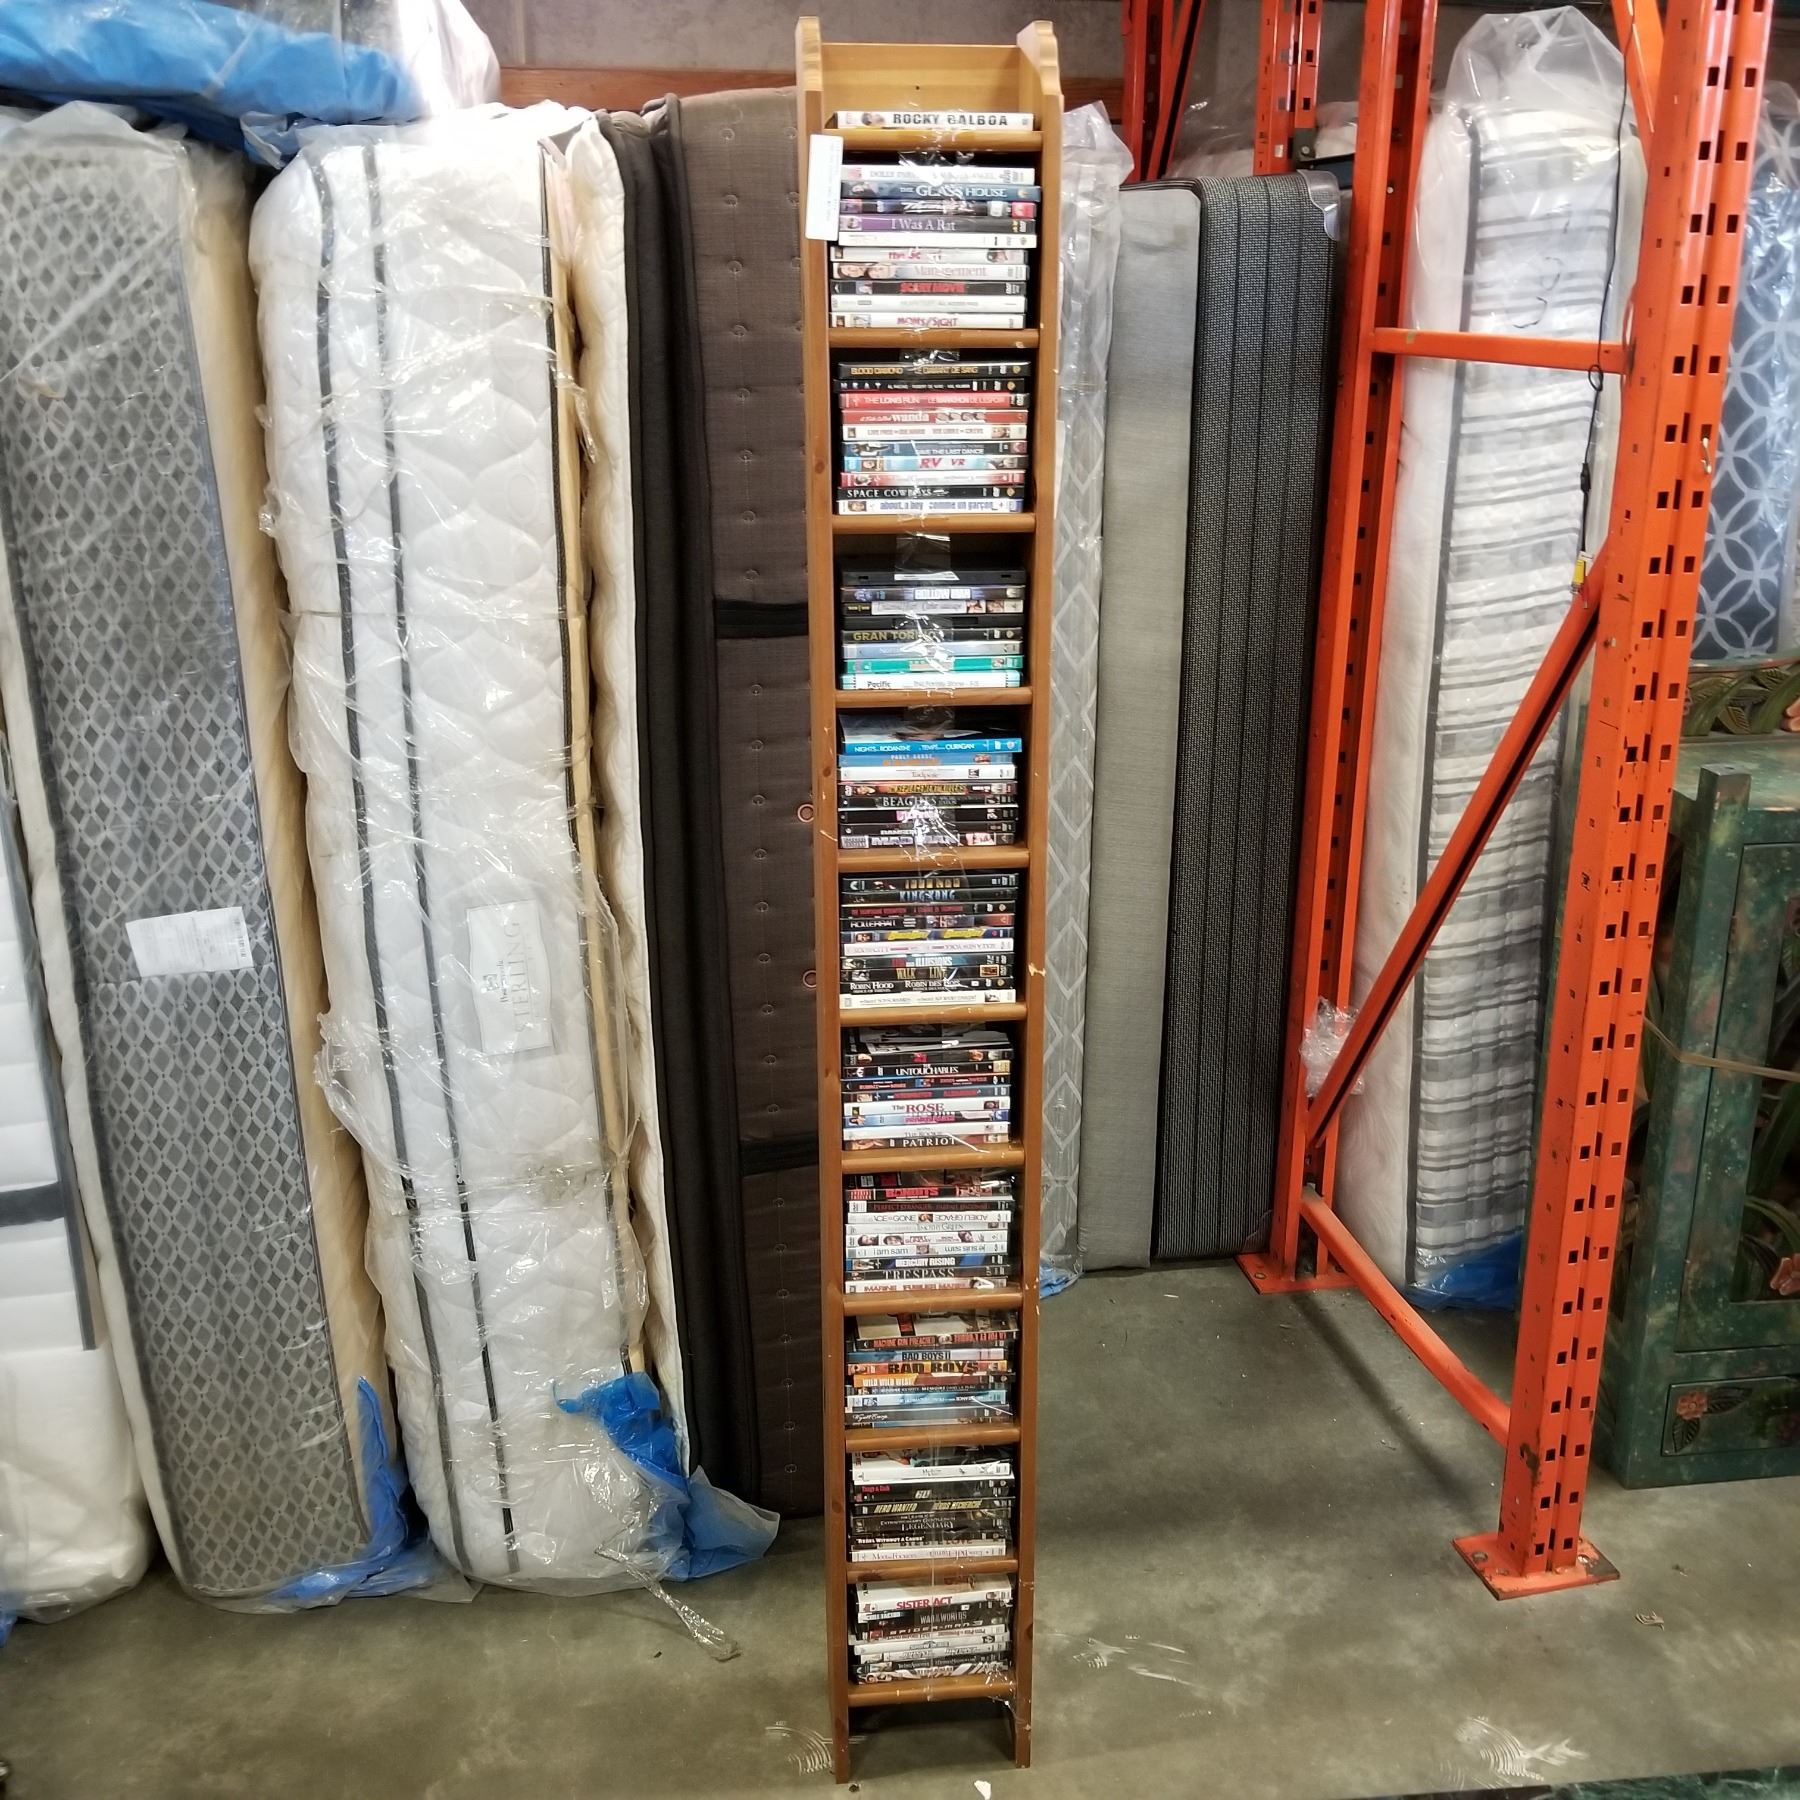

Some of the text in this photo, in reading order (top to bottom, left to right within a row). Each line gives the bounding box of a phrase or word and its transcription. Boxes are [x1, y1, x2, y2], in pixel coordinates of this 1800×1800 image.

[893, 113, 1008, 125] ROCKY BALBOA
[915, 185, 962, 198] GLASS
[965, 187, 1007, 198] HOUSE
[891, 218, 956, 232] I Was A Rat
[864, 396, 879, 404] THE
[879, 396, 902, 404] LONG
[919, 458, 966, 469] RV VR
[847, 489, 880, 498] SPACE
[853, 632, 887, 641] GRAN
[900, 890, 956, 901] KING KONG
[915, 956, 953, 966] ILLUSIONS
[896, 966, 948, 979] WALK LINE
[850, 982, 871, 990] ROBIN
[872, 981, 894, 990] HOOD
[904, 980, 927, 988] ROBIN
[895, 1066, 959, 1076] UNTOUCHABLES
[905, 1103, 944, 1113] ROSE
[902, 1137, 957, 1148] PATRIOT
[895, 1258, 956, 1267] MERCURY RISING
[882, 1268, 955, 1280] TRESPASS
[873, 1338, 897, 1347] MACHINE
[902, 1351, 950, 1360] BAD BOYS II
[888, 1361, 979, 1374] BAD BOYS
[862, 1377, 914, 1387] WILD WILD WEST
[874, 1504, 892, 1513] HERO
[892, 1503, 918, 1512] WANTED
[901, 1521, 954, 1531] LEGENDARY
[896, 1597, 953, 1610] SISTER ACT
